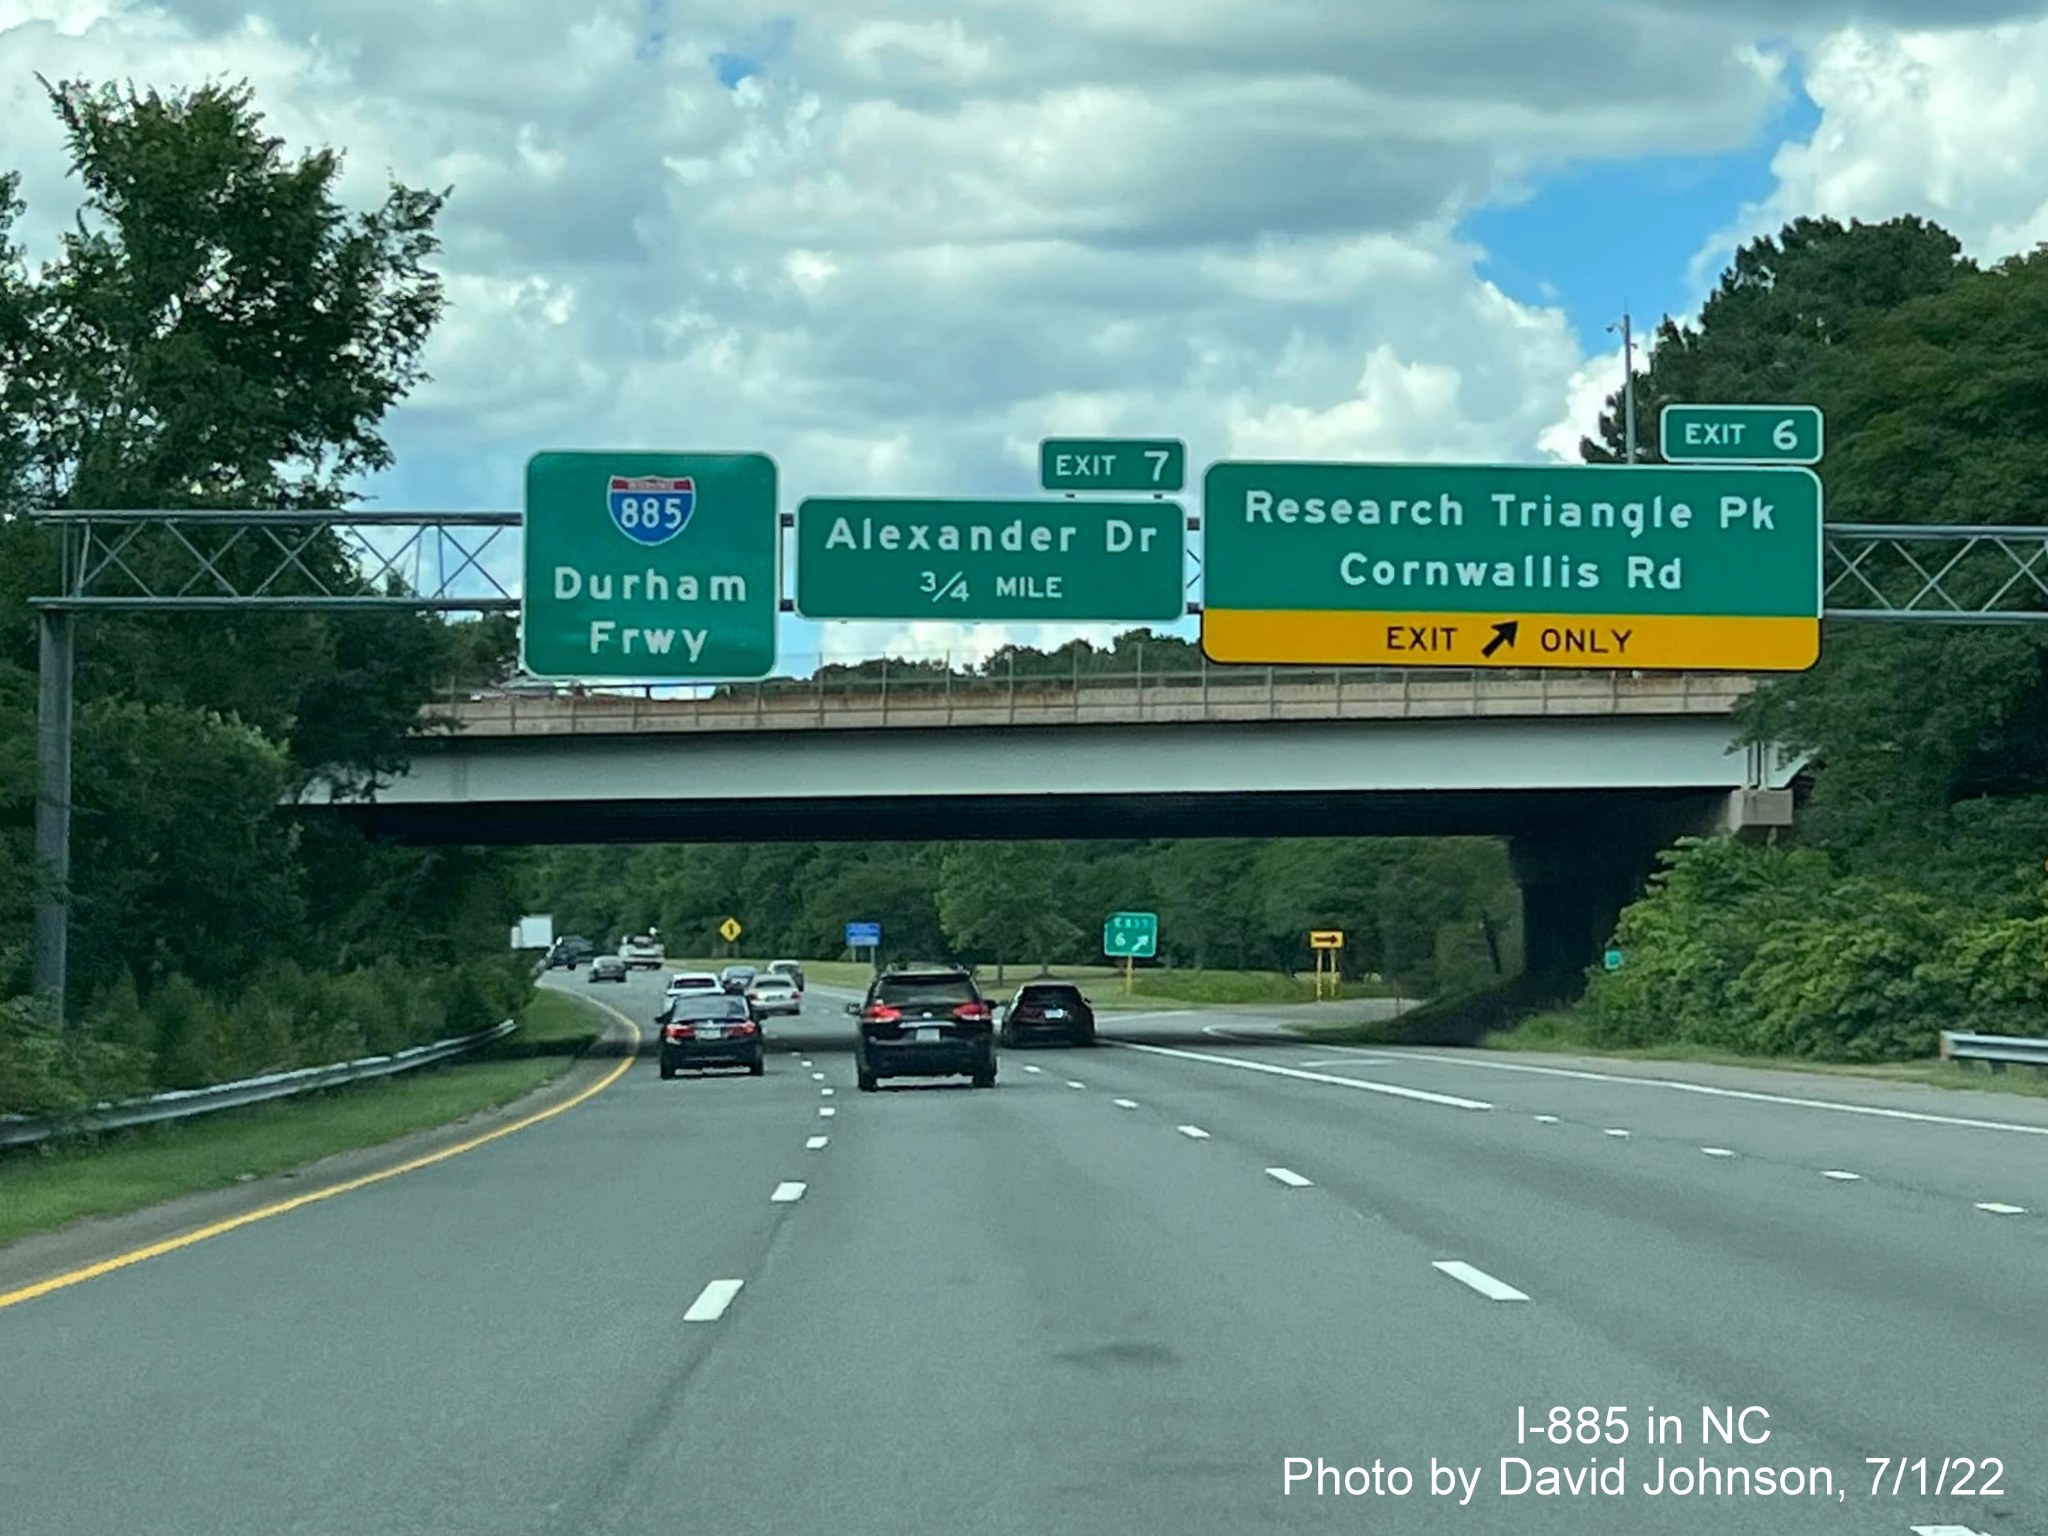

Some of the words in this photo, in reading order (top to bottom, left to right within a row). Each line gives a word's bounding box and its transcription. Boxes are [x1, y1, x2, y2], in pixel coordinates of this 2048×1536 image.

[1684, 424, 1746, 444] EXIT
[1772, 419, 1798, 450] 6
[1056, 455, 1117, 476] EXIT
[1144, 450, 1170, 481] 7
[621, 497, 682, 529] 885
[1245, 490, 1463, 526] Research
[1491, 493, 1692, 538] Triangle
[1720, 496, 1775, 530] Pk
[825, 517, 1076, 552] Alexander
[1106, 519, 1157, 552] Dr
[554, 566, 746, 601] Durham
[919, 571, 969, 603] 3/4
[996, 576, 1062, 598] MILE
[1340, 552, 1600, 588] Cornwallis
[1628, 556, 1681, 589] Rd
[590, 620, 708, 663] Frwy
[1387, 626, 1458, 651] EXIT
[1541, 628, 1632, 653] ONLY
